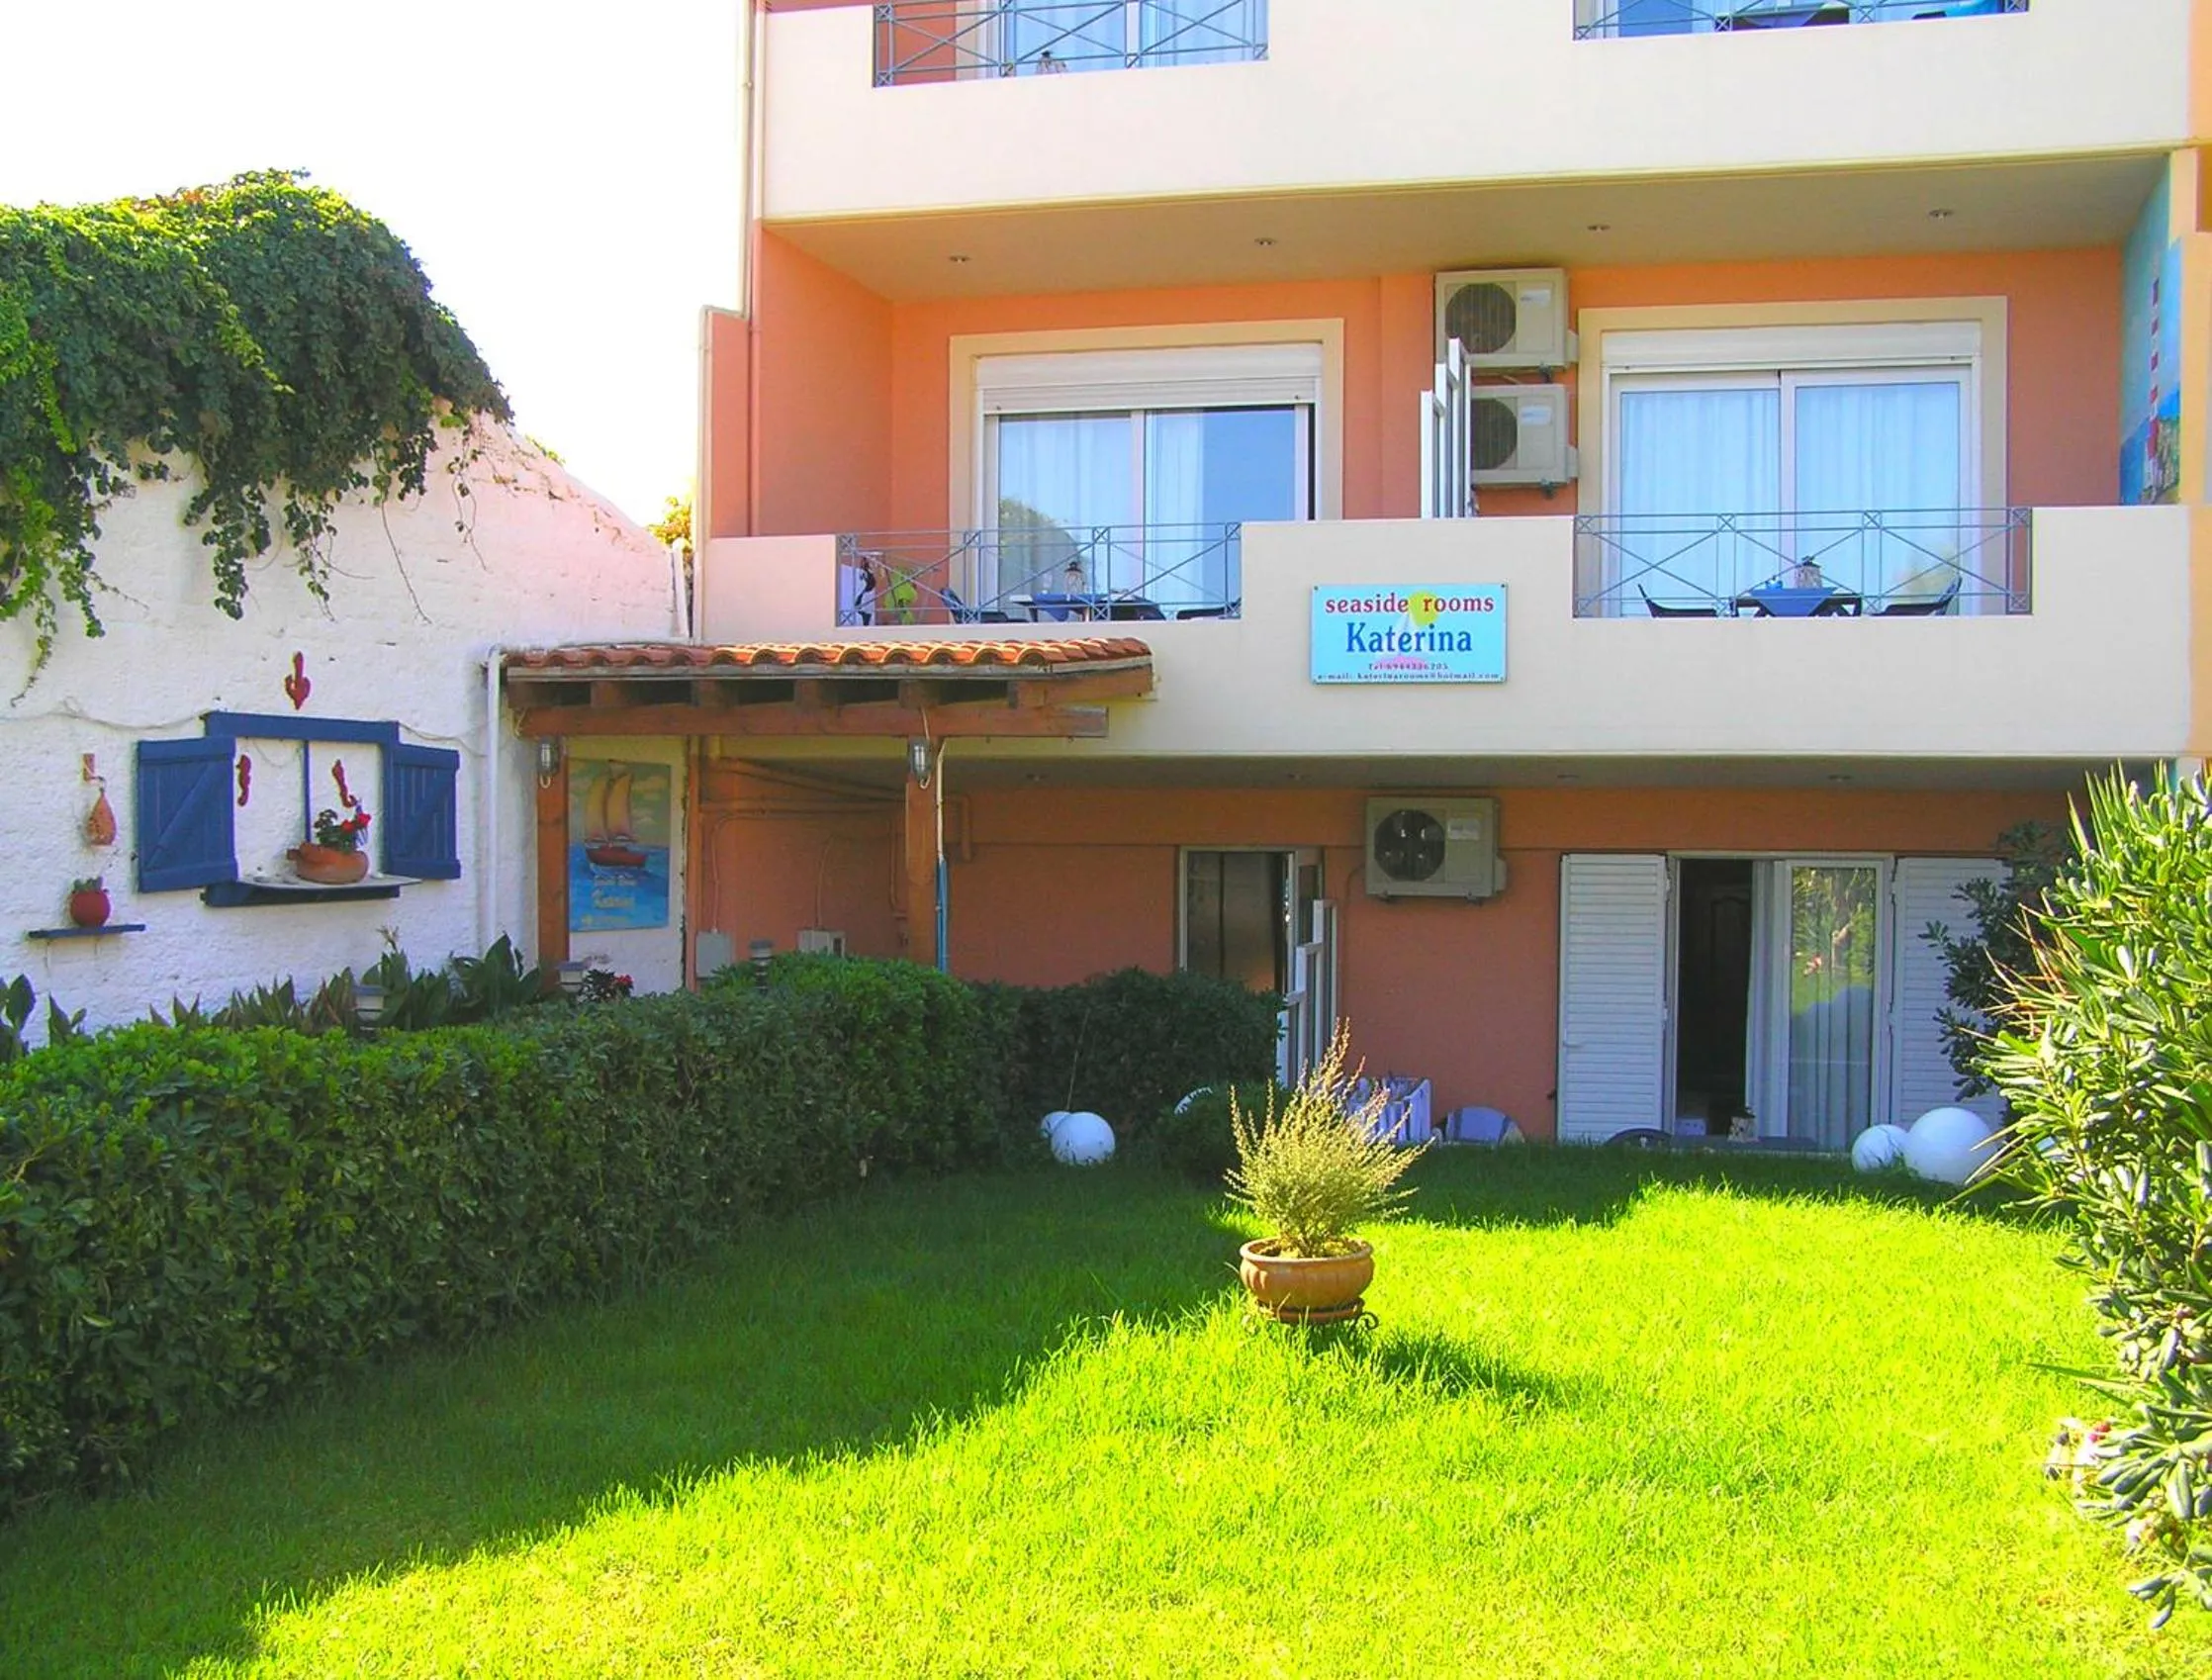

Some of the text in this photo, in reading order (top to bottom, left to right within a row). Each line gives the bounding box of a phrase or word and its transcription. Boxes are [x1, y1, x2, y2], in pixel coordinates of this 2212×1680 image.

[1325, 593, 1495, 613] seaside rooms
[1345, 621, 1473, 653] Katerina
